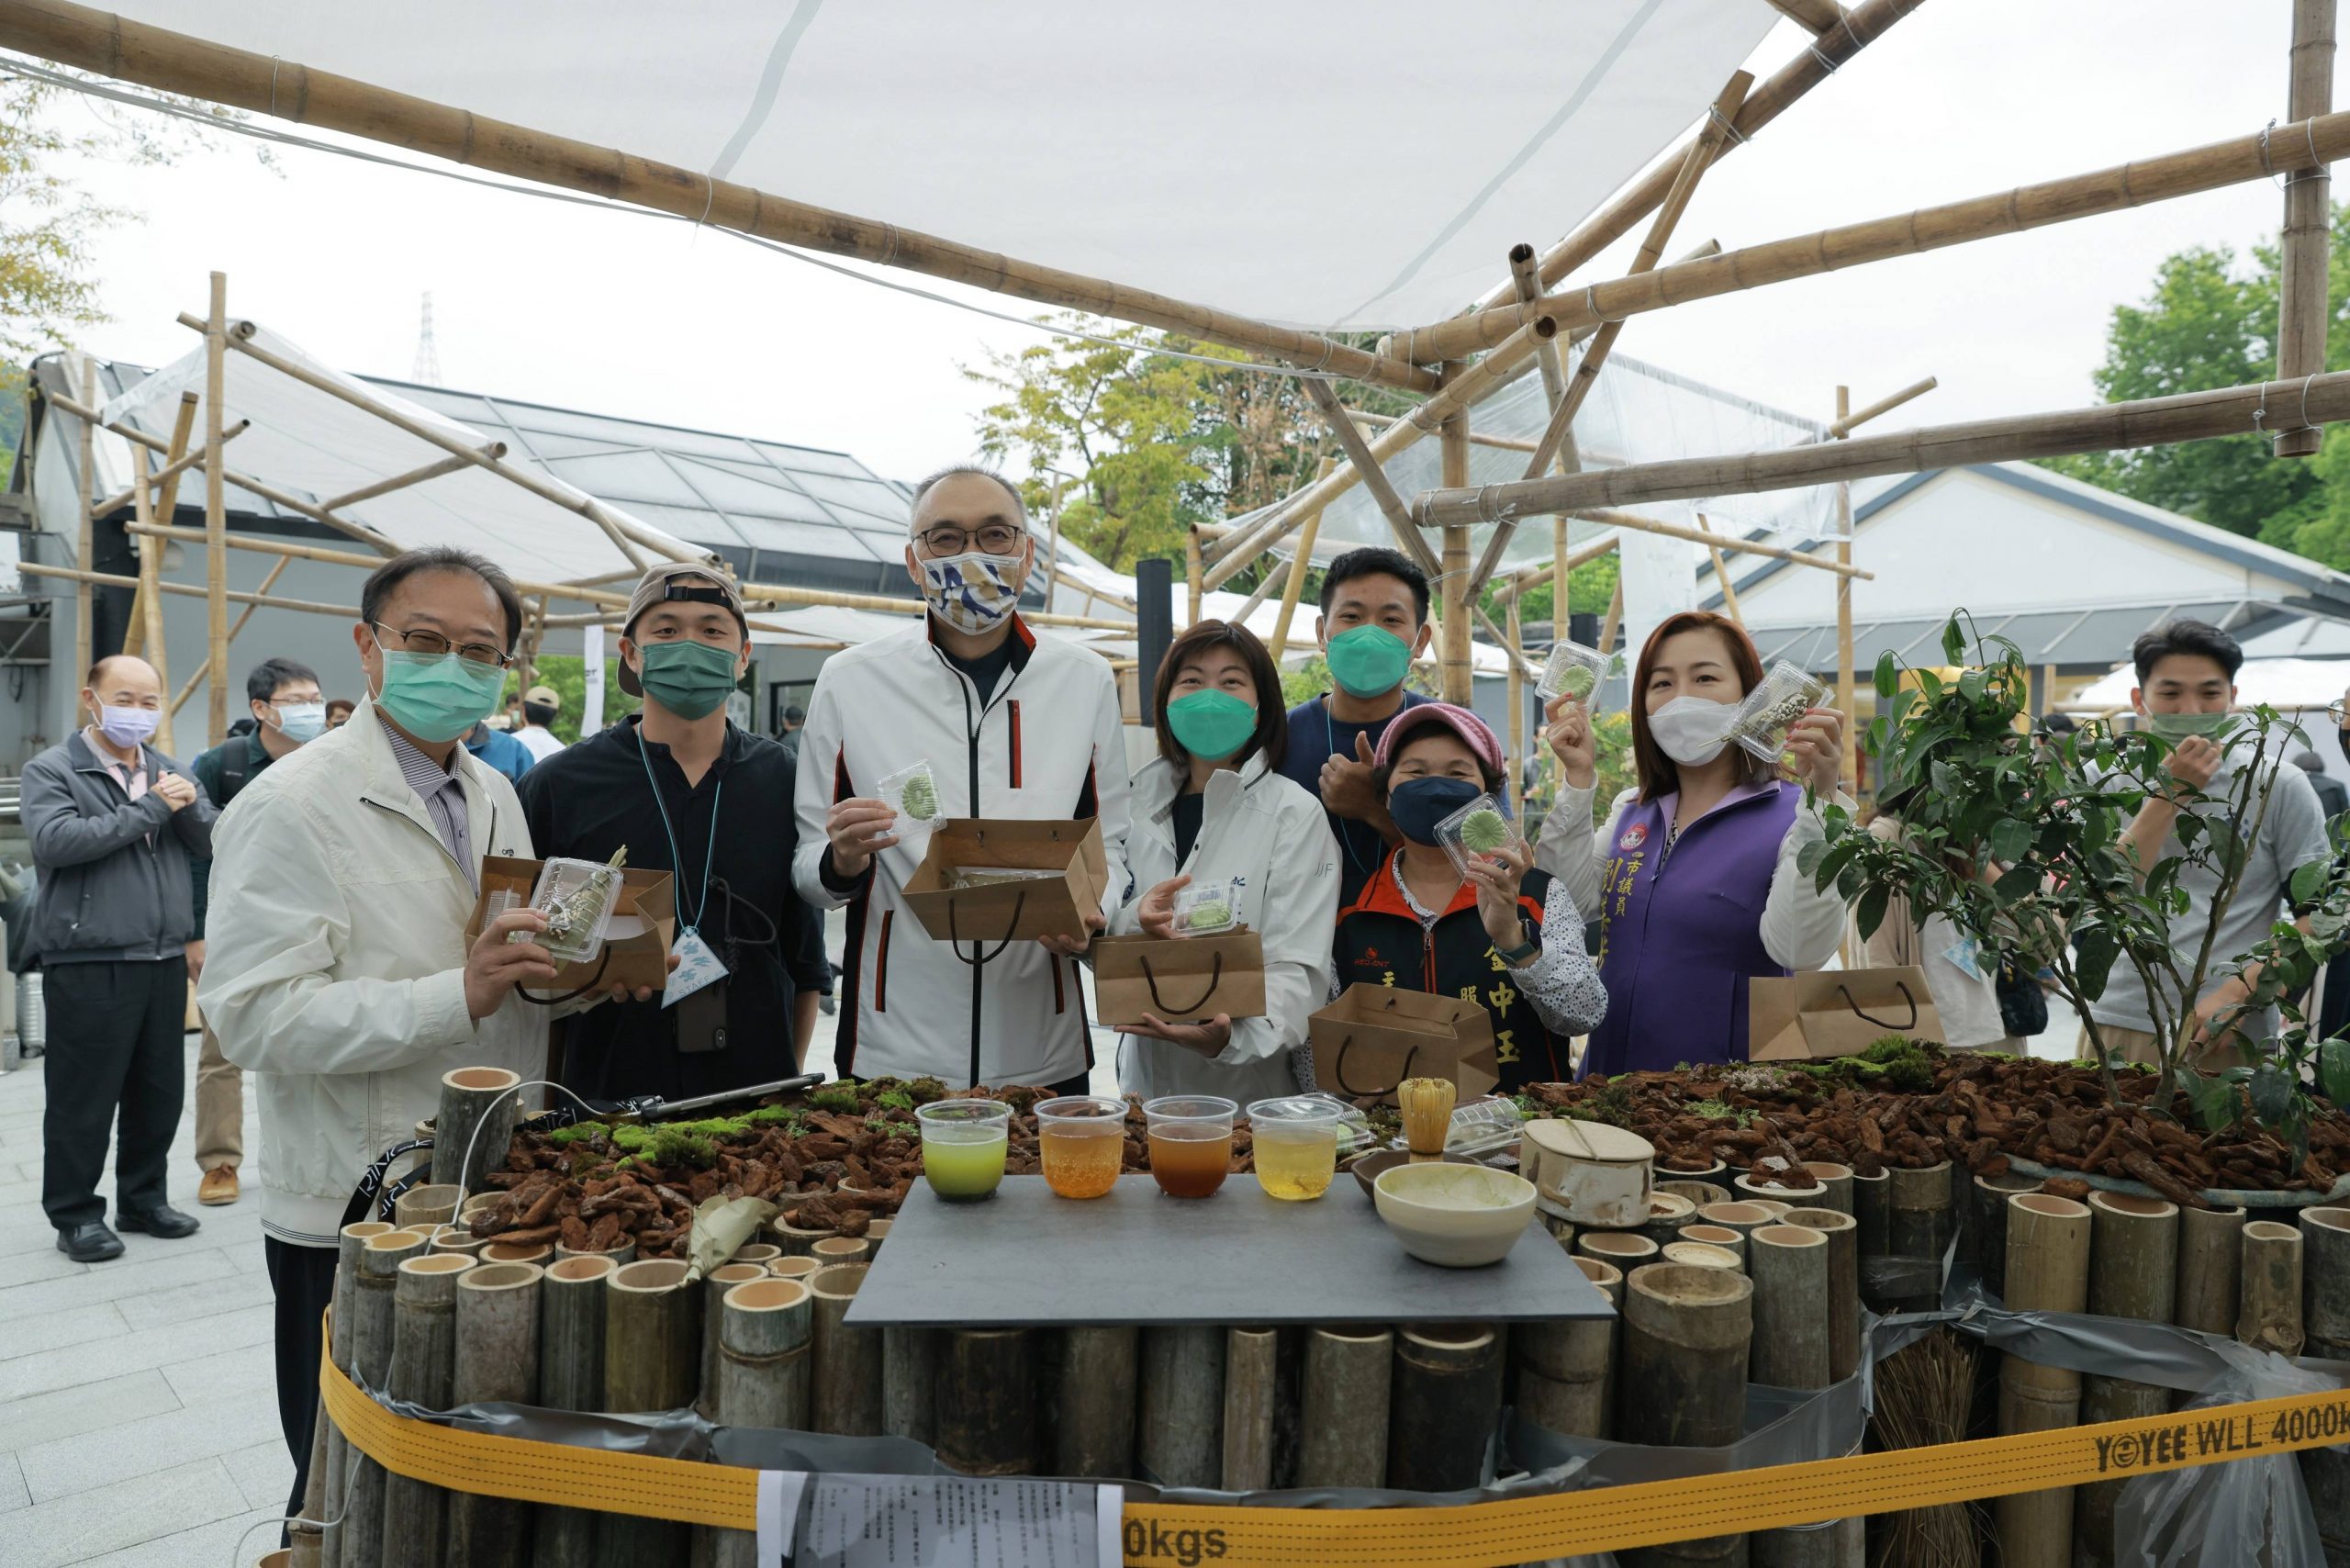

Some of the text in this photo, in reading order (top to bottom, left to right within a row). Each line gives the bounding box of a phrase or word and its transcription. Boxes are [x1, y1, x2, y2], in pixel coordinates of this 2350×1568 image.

[1615, 859, 1643, 917] 市議員
[2197, 1415, 2262, 1456] WLL
[1124, 1518, 1227, 1567] 0kgs
